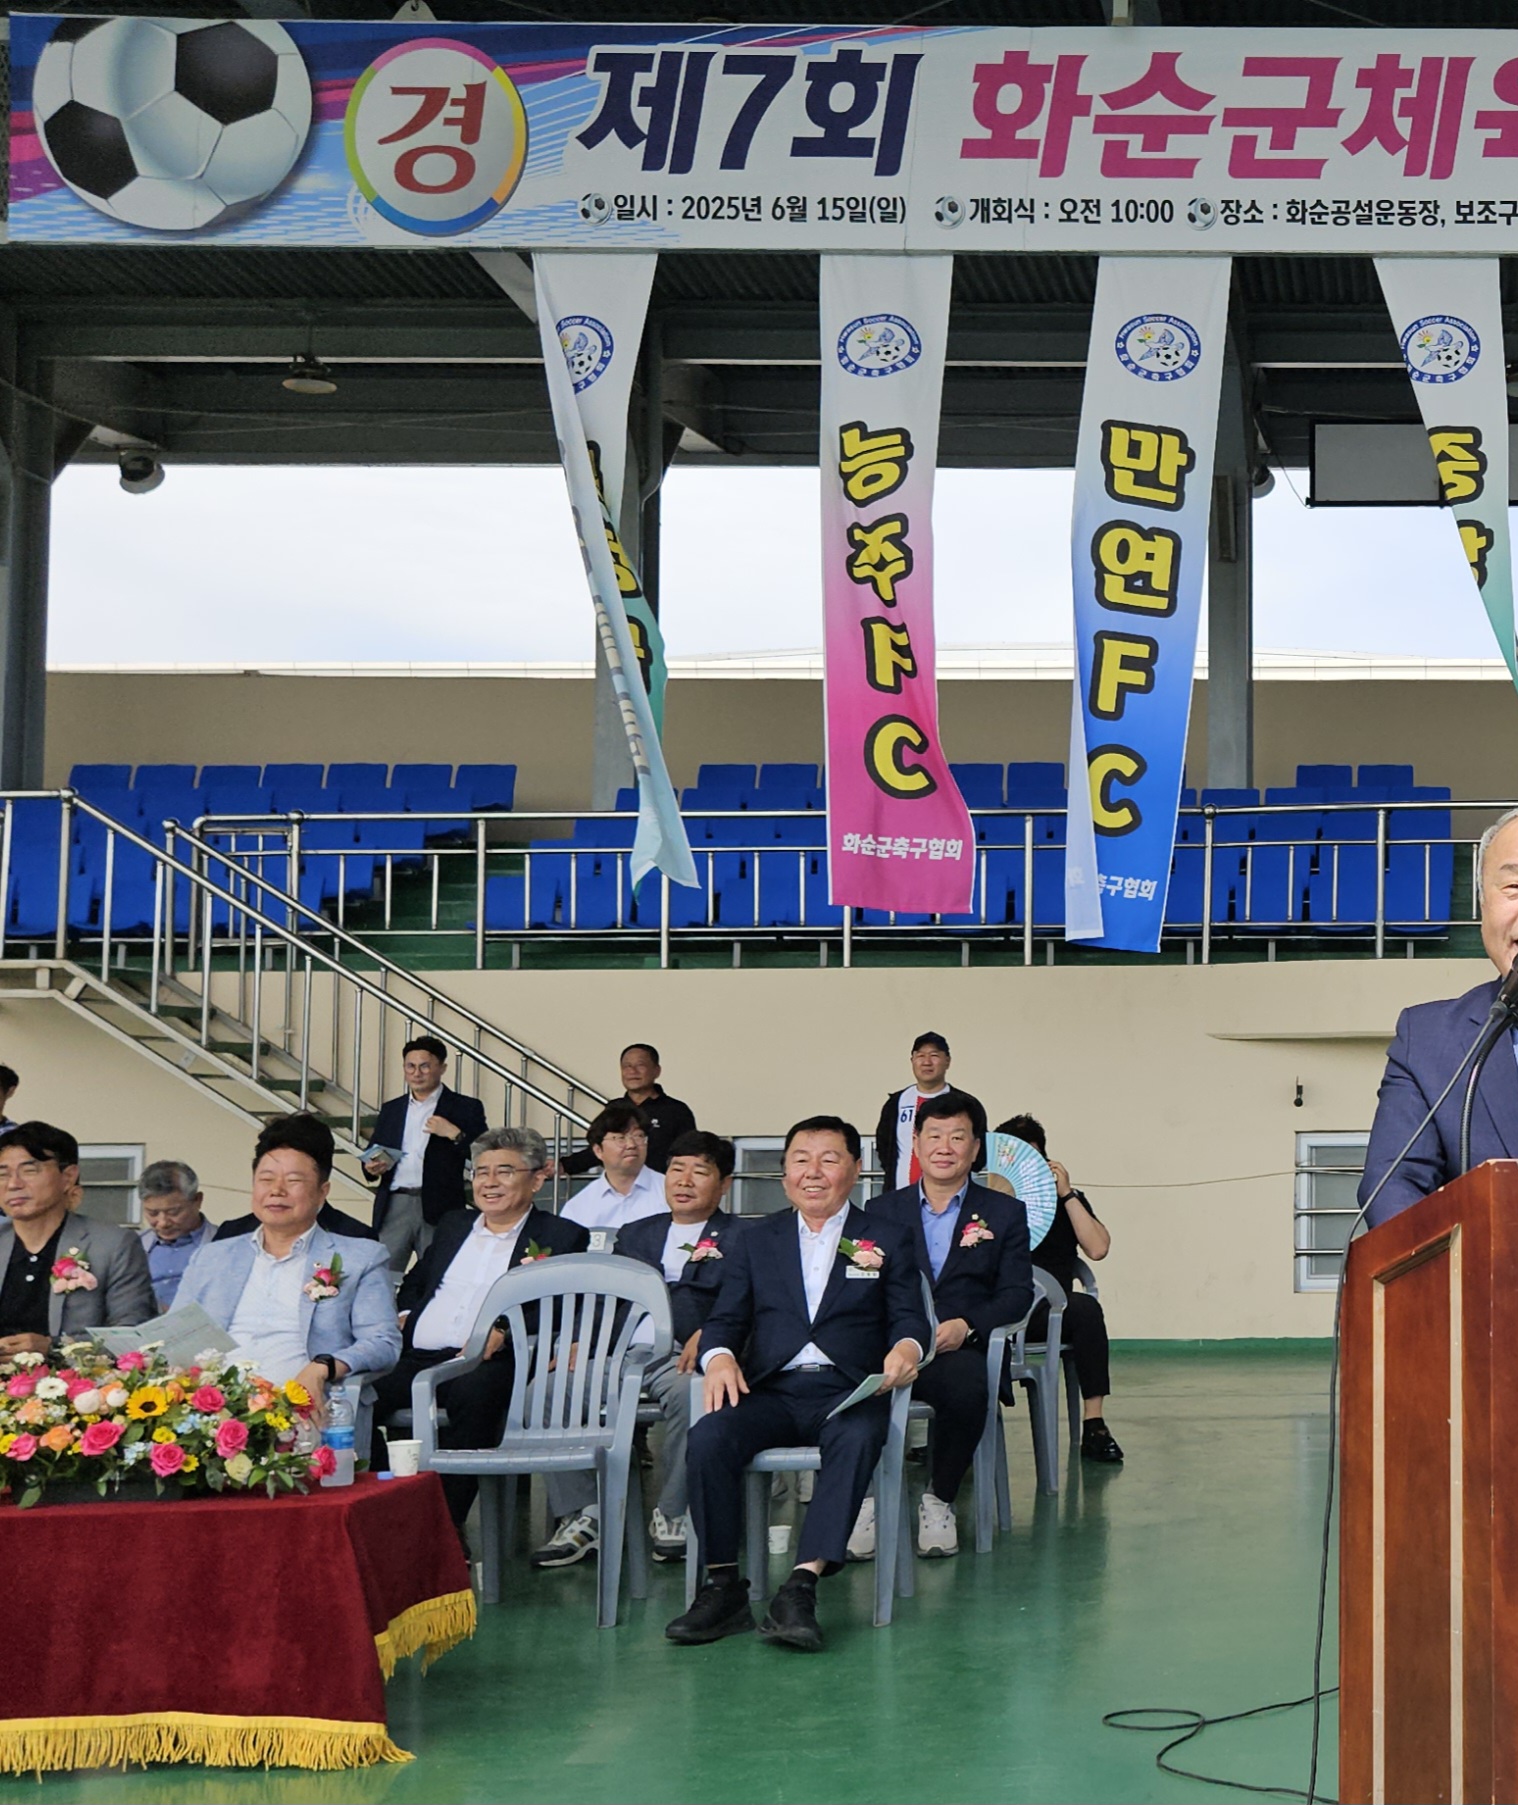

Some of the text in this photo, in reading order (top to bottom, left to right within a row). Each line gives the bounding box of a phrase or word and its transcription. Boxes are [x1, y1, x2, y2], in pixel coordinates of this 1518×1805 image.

[575, 50, 925, 177] 제7회
[377, 80, 484, 194] 경
[613, 194, 658, 221] 일시
[681, 195, 762, 222] 2025년
[771, 195, 807, 223] 6월
[816, 195, 906, 224] 15일(일)
[969, 197, 1035, 224] 개회식
[1058, 198, 1101, 225] 오전
[1111, 199, 1174, 224] 10:00
[1219, 199, 1264, 226] 장소
[1286, 198, 1446, 228] 화순공설운동장,
[839, 421, 937, 800] 능주FC
[1086, 419, 1195, 838] 만연FC
[842, 831, 964, 862] 화순군축구협회
[900, 1109, 913, 1123] 61
